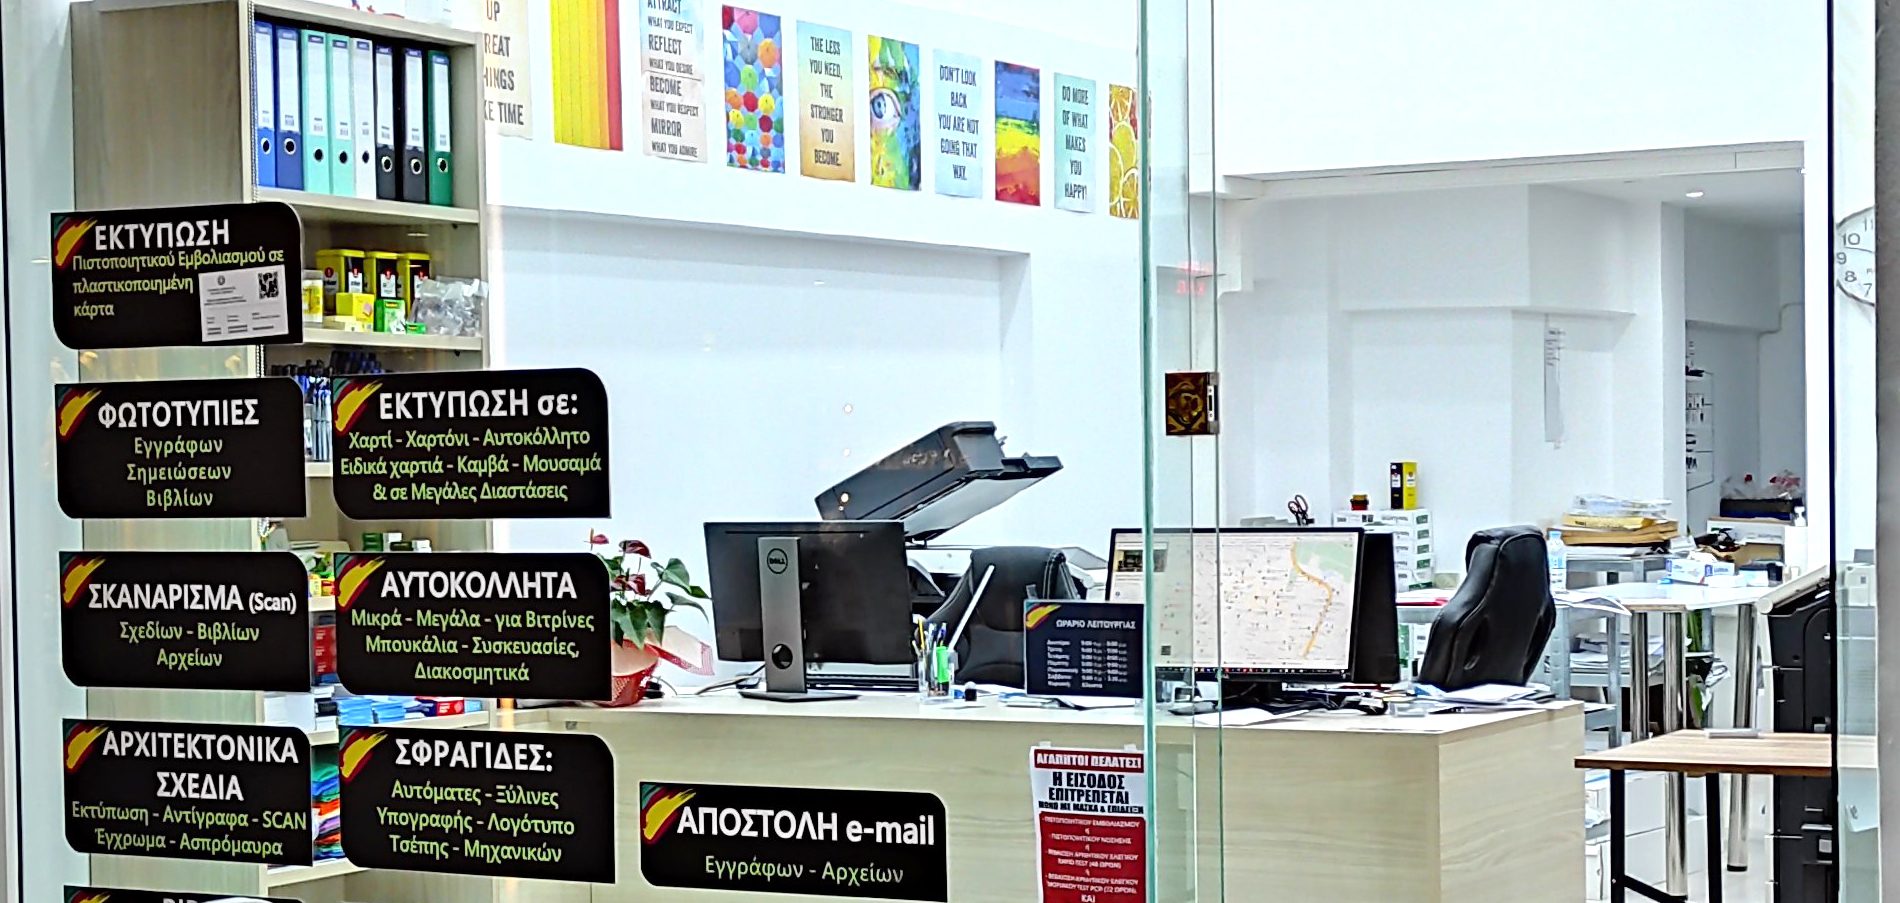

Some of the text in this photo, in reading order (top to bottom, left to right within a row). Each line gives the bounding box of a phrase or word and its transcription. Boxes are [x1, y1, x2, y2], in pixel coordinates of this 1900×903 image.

[486, 0, 500, 21] UP
[484, 33, 510, 57] REAT
[648, 34, 682, 56] REFLECT
[810, 36, 841, 56] THE LESS
[484, 66, 515, 91] HINGS
[809, 59, 843, 80] YOU NEED,
[939, 64, 977, 87] DON'T LOOK
[649, 75, 682, 97] BECOME
[819, 83, 833, 99] THE
[1062, 85, 1089, 106] DO MORE
[950, 91, 967, 109] BACK
[497, 101, 524, 126] TIME
[810, 103, 844, 123] STRONGER
[937, 112, 979, 135] YOU ARE NOT
[1062, 109, 1088, 129] OF WHAT
[651, 117, 682, 138] MIRROR
[820, 128, 834, 143] YOU
[940, 137, 977, 159] GOING THAT
[1065, 134, 1086, 153] MAKES
[1069, 159, 1082, 176] YOU
[95, 219, 230, 250] ΕΚΤΥΠΩΣΗ
[1841, 232, 1861, 246] 10
[72, 246, 285, 272] Πιστοποιητικού Εμβολιασμού σε
[1836, 251, 1847, 265] 9
[72, 273, 194, 294] πλαστικοποιημένη
[1844, 270, 1857, 283] 8
[1863, 282, 1873, 297] 7
[74, 301, 115, 319] κάρτα
[98, 398, 259, 428] ΦΩΤΟΤΥΠΙΕΣ
[379, 388, 578, 420] ΕΚΤΥΠΩΣΗ σε:
[134, 435, 223, 459] Εγγράφων
[349, 429, 392, 452] Χαρτί
[405, 428, 469, 451] Χαρτόνι
[482, 426, 590, 449] Αυτοκόλλητο
[126, 461, 232, 486] Σημειώσεων
[340, 456, 387, 475] Ειδικά
[390, 454, 443, 479] χαρτιά
[457, 454, 509, 477] Καμβά
[523, 452, 602, 476] Μουσαμά
[146, 487, 214, 511] Βιβλίων
[373, 480, 568, 505] & σε Μεγάλες Διαστάσεις
[380, 571, 578, 600] ΑΥΤΟΚΟΛΛΗΤΑ
[88, 583, 297, 615] ΣΚΑΝΑΡΙΣΜΑ (Scan)
[351, 607, 402, 630] Μικρά
[416, 608, 481, 632] Μεγάλα
[495, 613, 522, 632] για
[526, 610, 595, 632] Βιτρίνες
[1055, 619, 1136, 630] ΩΡΑΡΙΟ ΛΕΙΤΟΥΡΓΙΑΣ
[119, 620, 183, 644] Σχεδίων
[197, 622, 260, 645] Βιβλίων
[366, 635, 458, 655] Μπουκάλια
[472, 635, 580, 658] Συσκευασίες,
[156, 648, 223, 671] Αρχείων
[414, 662, 530, 685] Διακοσμητικά
[102, 730, 299, 763] ΑΡΧΙΤΕΚΤΟΝΙΚΑ
[395, 738, 553, 772] ΣΦΡΑΓΙΔΕΣ:
[1036, 752, 1089, 766] ΑΓΑΠΗΤΟΙ
[156, 771, 244, 801] ΣΧΕΔΙΑ
[1052, 771, 1125, 790] Η ΕΙΣΟΔΟΣ
[391, 779, 481, 806] Αυτόματες
[496, 784, 559, 809] Ξύλινες
[1048, 787, 1129, 805] ΕΠΙΤΡΕΠΕΤΑΙ
[72, 800, 149, 826] Εκτύπωση
[162, 805, 249, 830] Αντίγραφα
[262, 811, 307, 830] SCAN
[376, 806, 473, 833] Υπογραφής
[487, 812, 575, 837] Λογότυπο
[676, 806, 935, 845] ΑΠΟΣΤΟΛΗ e-mail
[94, 827, 166, 851] Έγχρωμα
[179, 832, 283, 859] Ασπρόμαυρα
[389, 834, 449, 859] Τσέπης
[464, 839, 562, 864] Μηχανικών
[705, 855, 803, 881] Εγγράφων
[821, 861, 904, 886] Αρχείων
